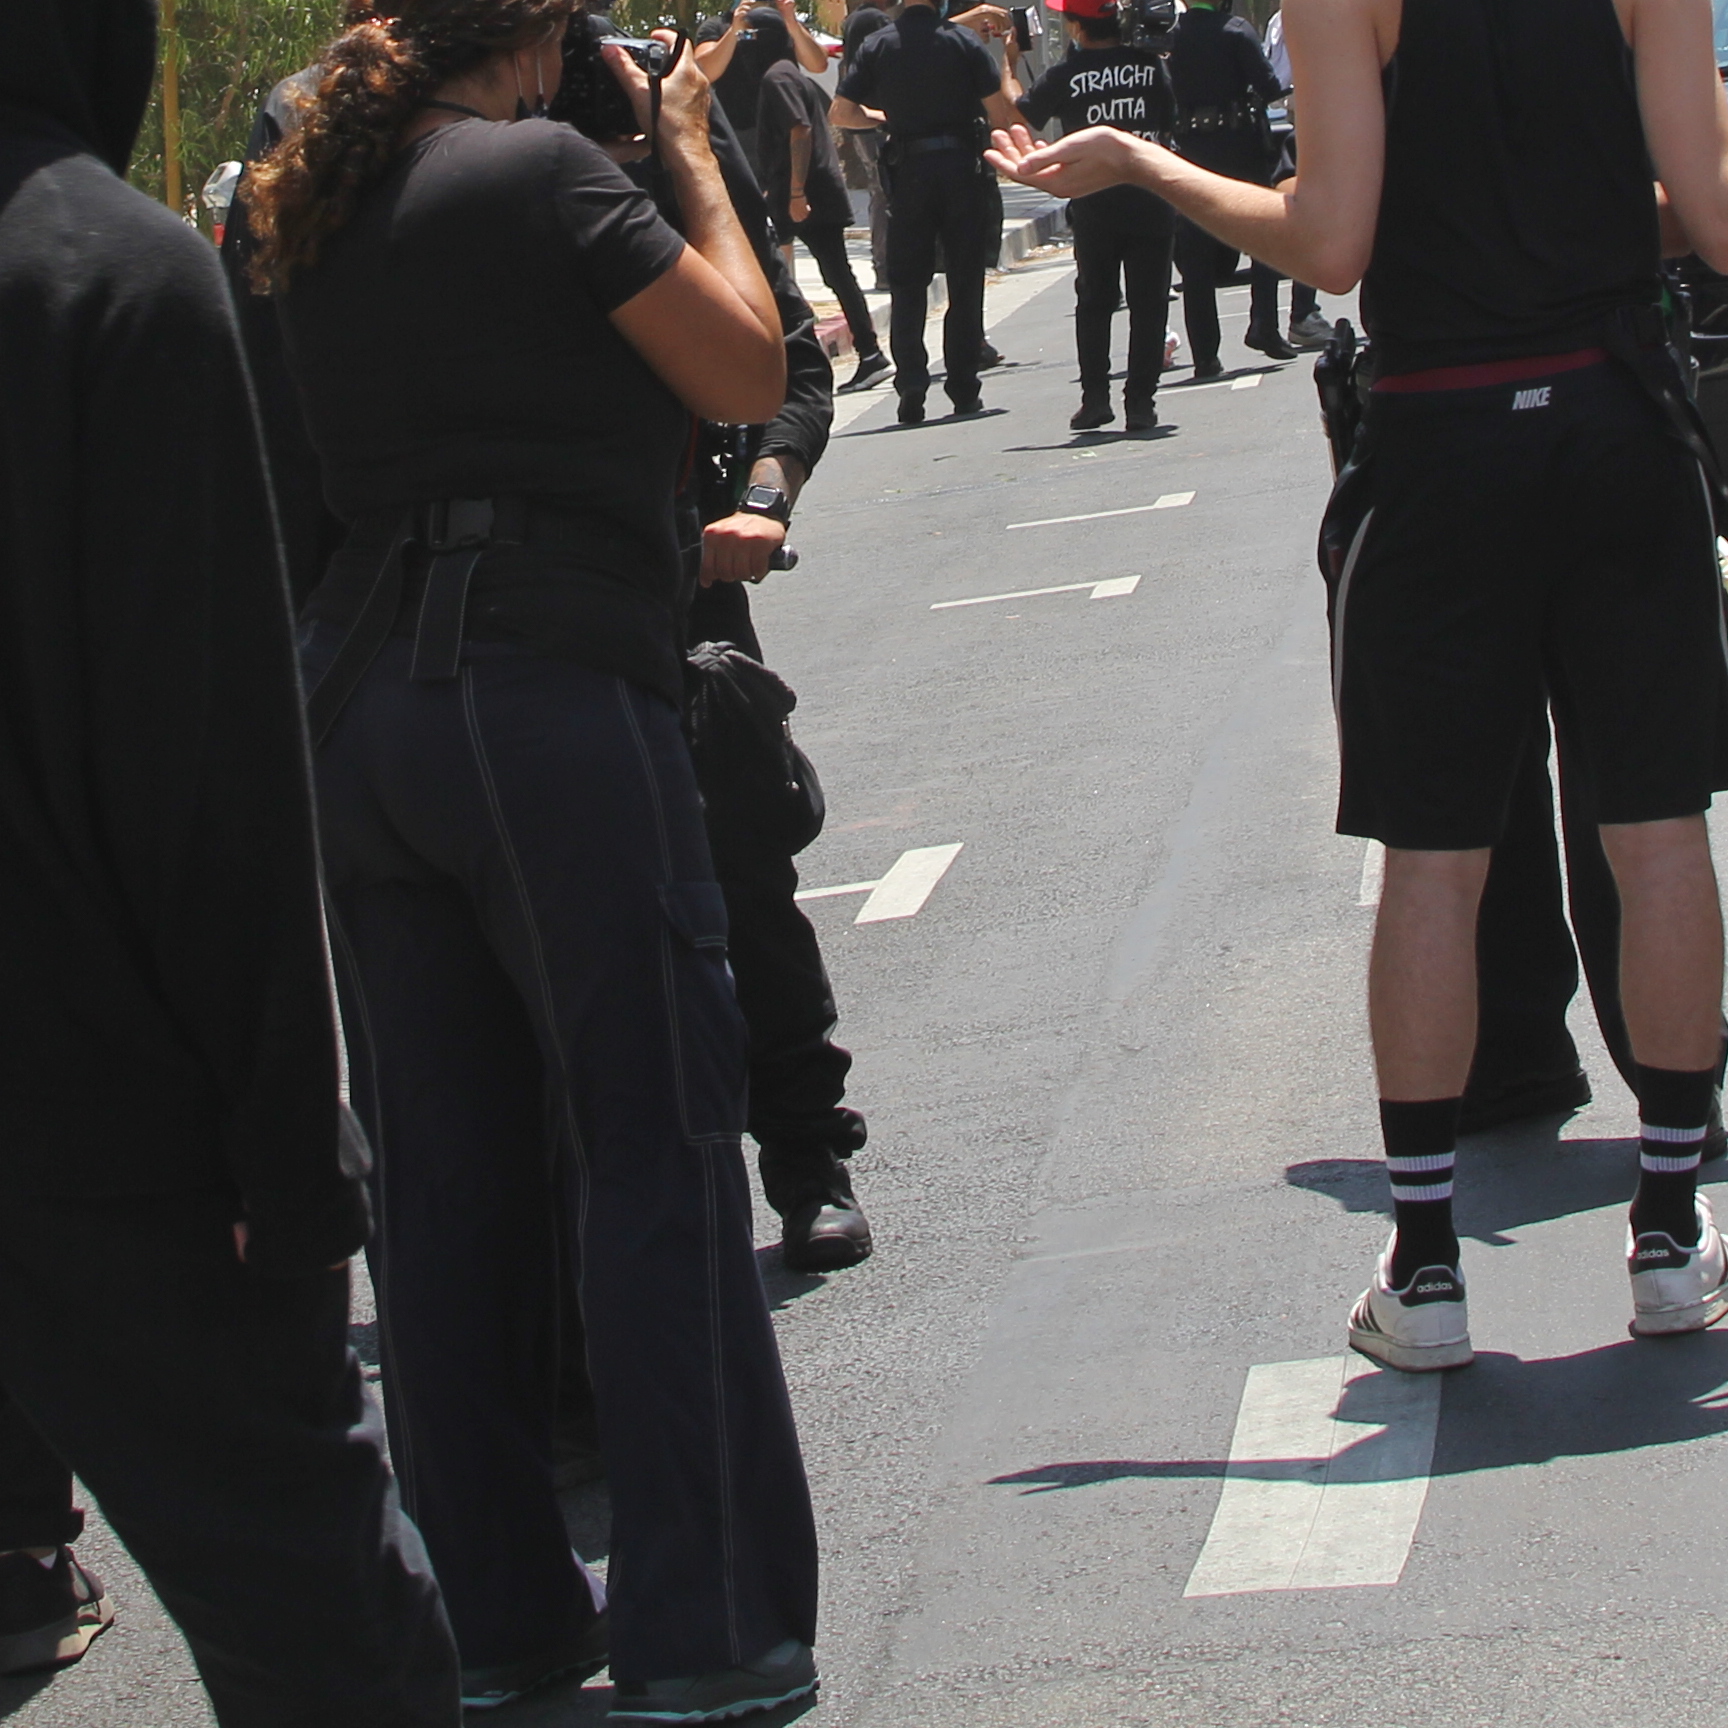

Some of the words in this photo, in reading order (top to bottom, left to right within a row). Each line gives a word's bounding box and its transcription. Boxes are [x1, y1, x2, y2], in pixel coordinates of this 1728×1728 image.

[1069, 64, 1155, 97] STRAIGHT
[1086, 96, 1145, 124] OUTTA
[1512, 386, 1552, 411] NIKE
[1636, 1249, 1670, 1260] adidas
[1417, 1281, 1453, 1293] adidas
